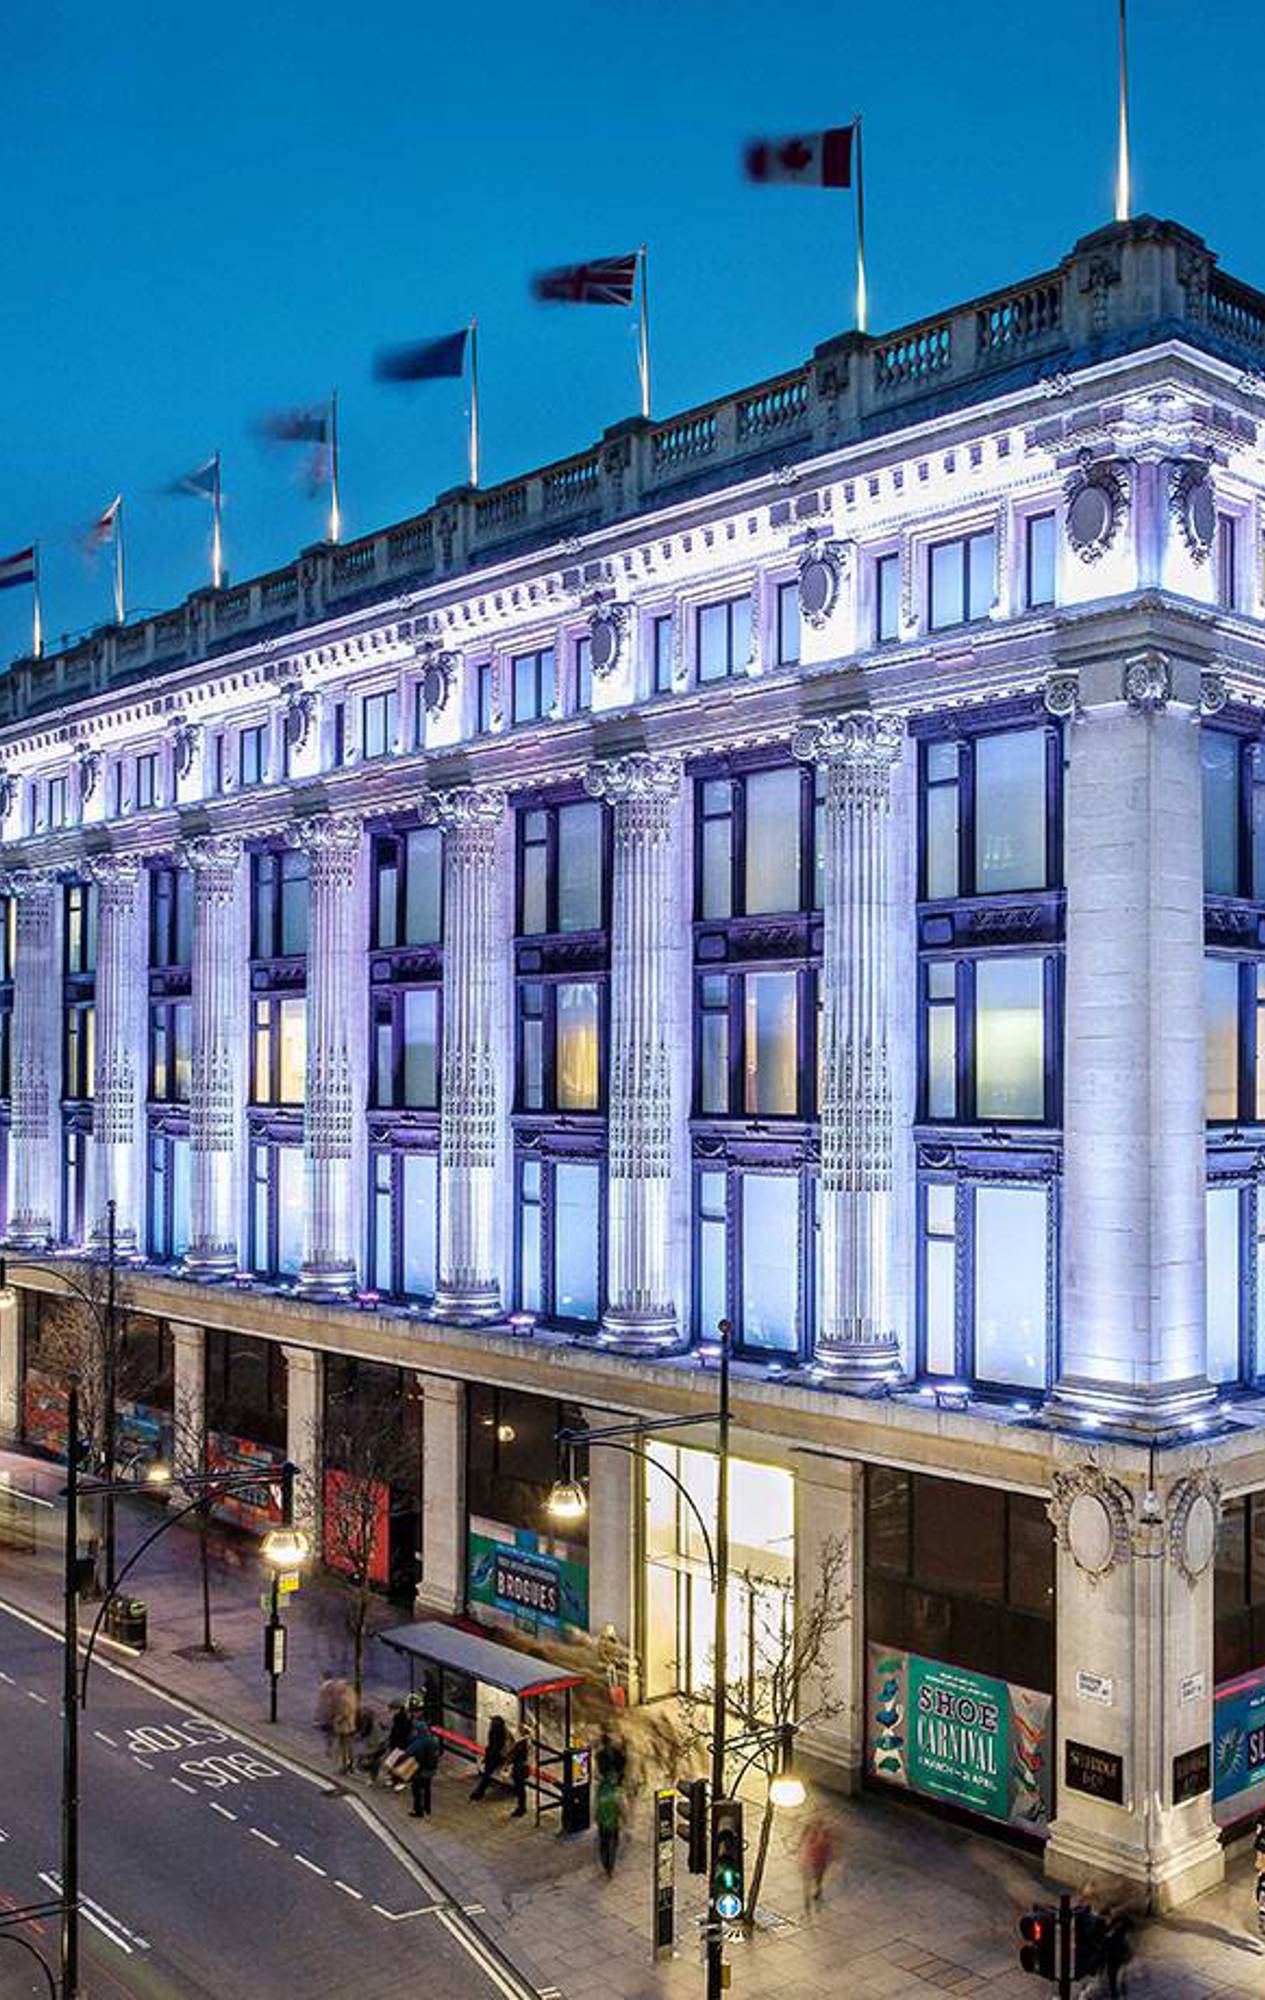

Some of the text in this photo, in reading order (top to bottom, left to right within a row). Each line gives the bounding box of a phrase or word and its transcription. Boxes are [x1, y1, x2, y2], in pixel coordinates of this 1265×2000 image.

[497, 1571, 557, 1612] BROGUES
[918, 1684, 999, 1734] SHOE
[124, 1718, 228, 1754] STOP
[917, 1713, 997, 1776] CARNIVAL
[180, 1752, 282, 1787] BUS
